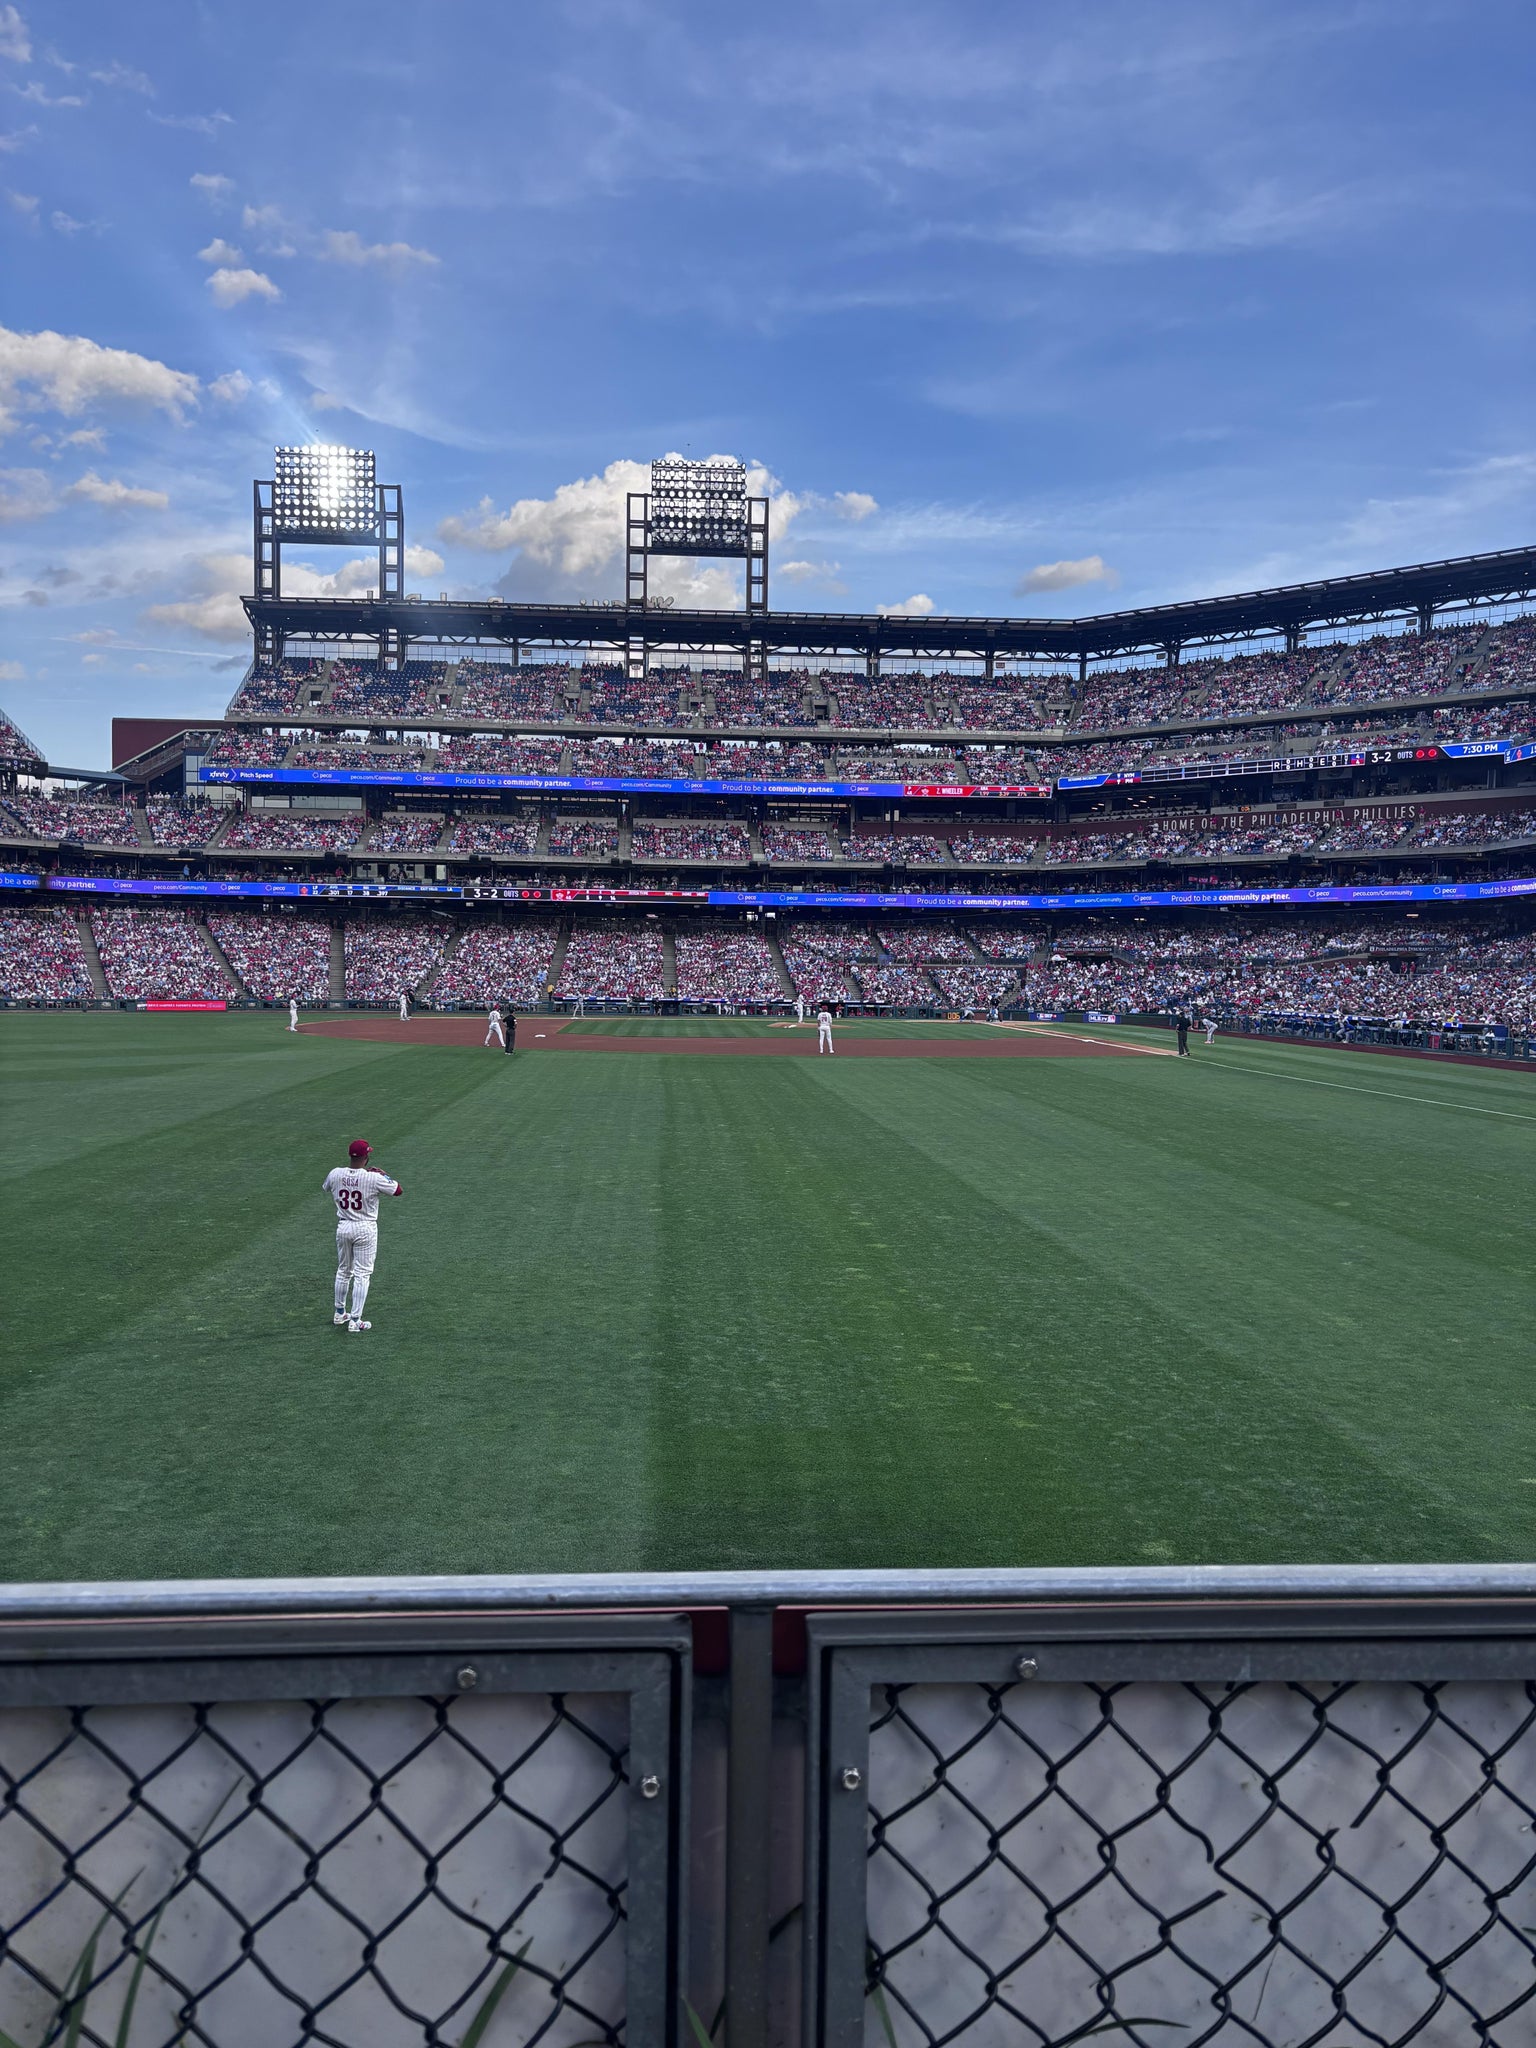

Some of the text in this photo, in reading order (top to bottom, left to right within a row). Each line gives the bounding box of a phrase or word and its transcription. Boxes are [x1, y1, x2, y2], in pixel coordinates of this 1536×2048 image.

[1462, 744, 1498, 754] 7:30 PM
[1397, 751, 1413, 759] OUTS
[503, 779, 542, 787] community
[768, 785, 807, 794] community
[1162, 818, 1194, 831] HOME
[1222, 816, 1244, 828] THE
[1354, 806, 1415, 820] PHILLIES
[1219, 893, 1259, 902] community
[1261, 892, 1290, 901] partner.
[342, 1177, 359, 1187] SOSA
[339, 1189, 362, 1211] 33
